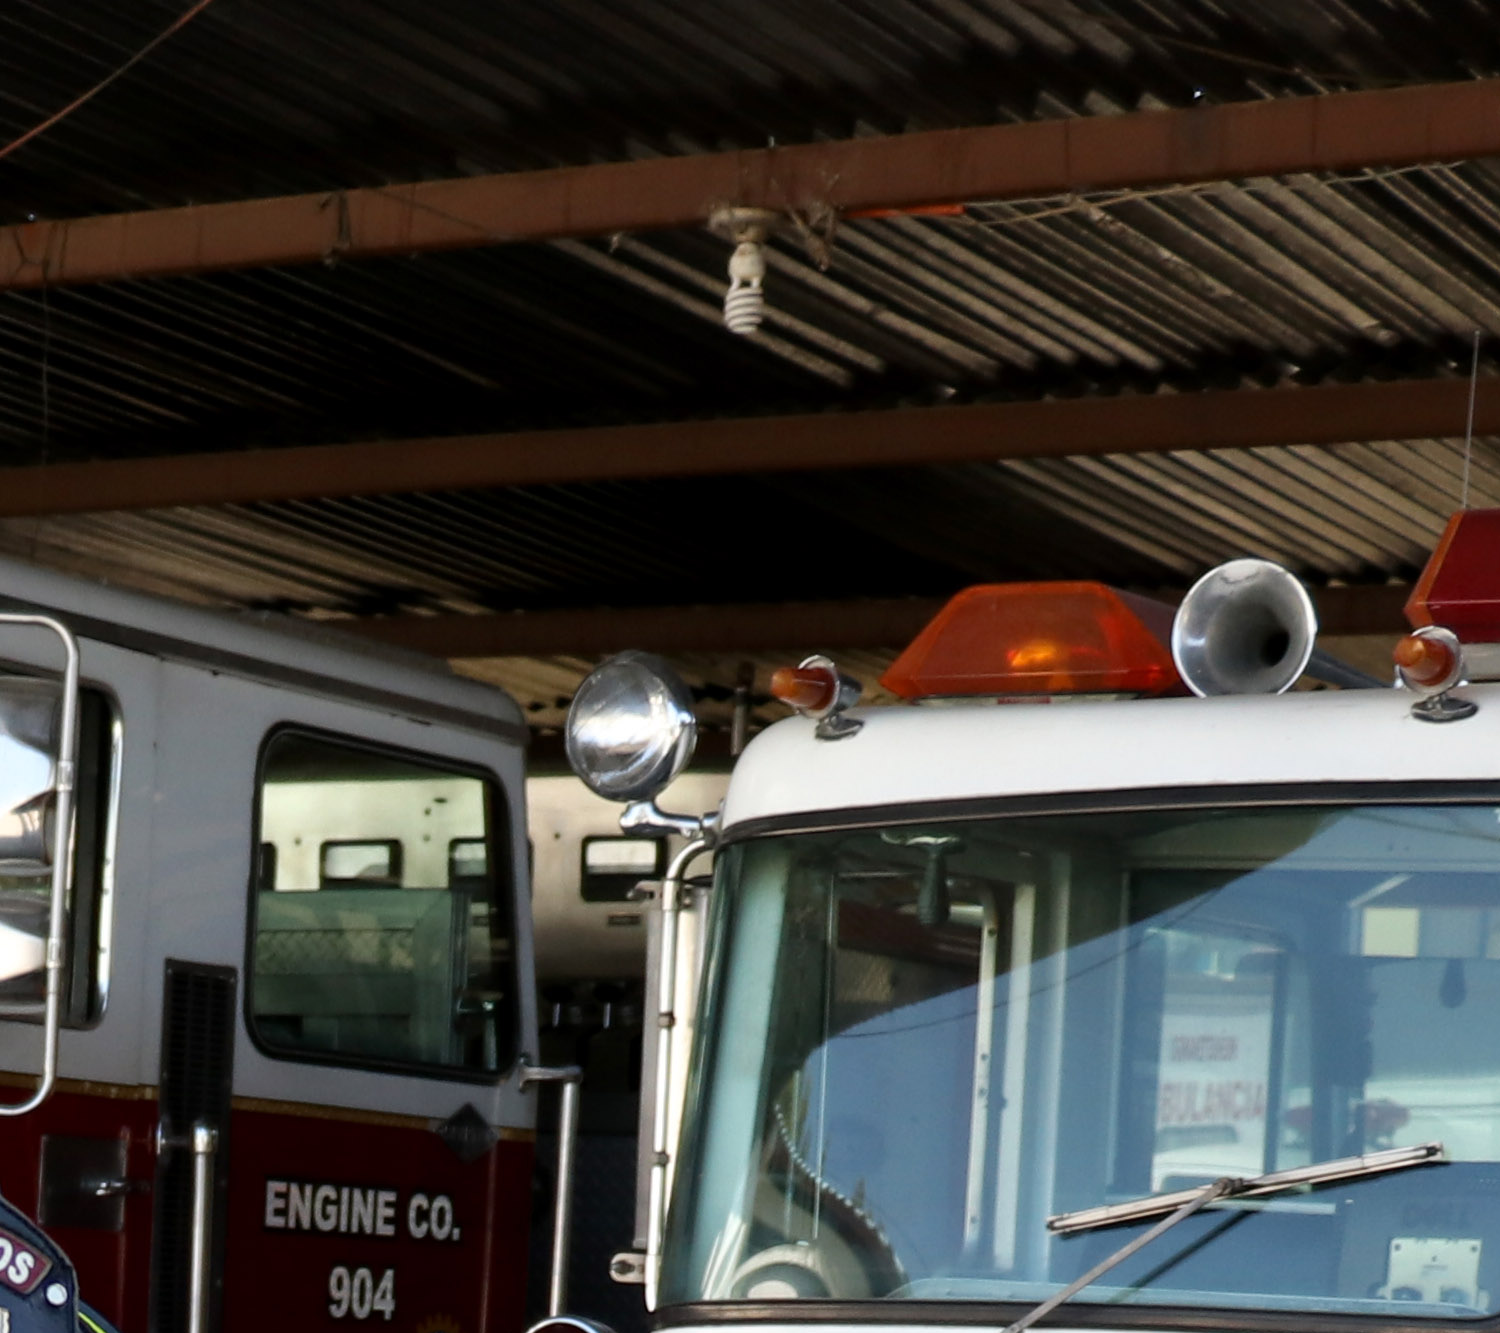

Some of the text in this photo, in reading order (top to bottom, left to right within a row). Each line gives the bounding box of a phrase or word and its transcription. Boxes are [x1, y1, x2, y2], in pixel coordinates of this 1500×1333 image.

[264, 1180, 461, 1241] ENGINE CO.
[328, 1265, 396, 1321] 904
